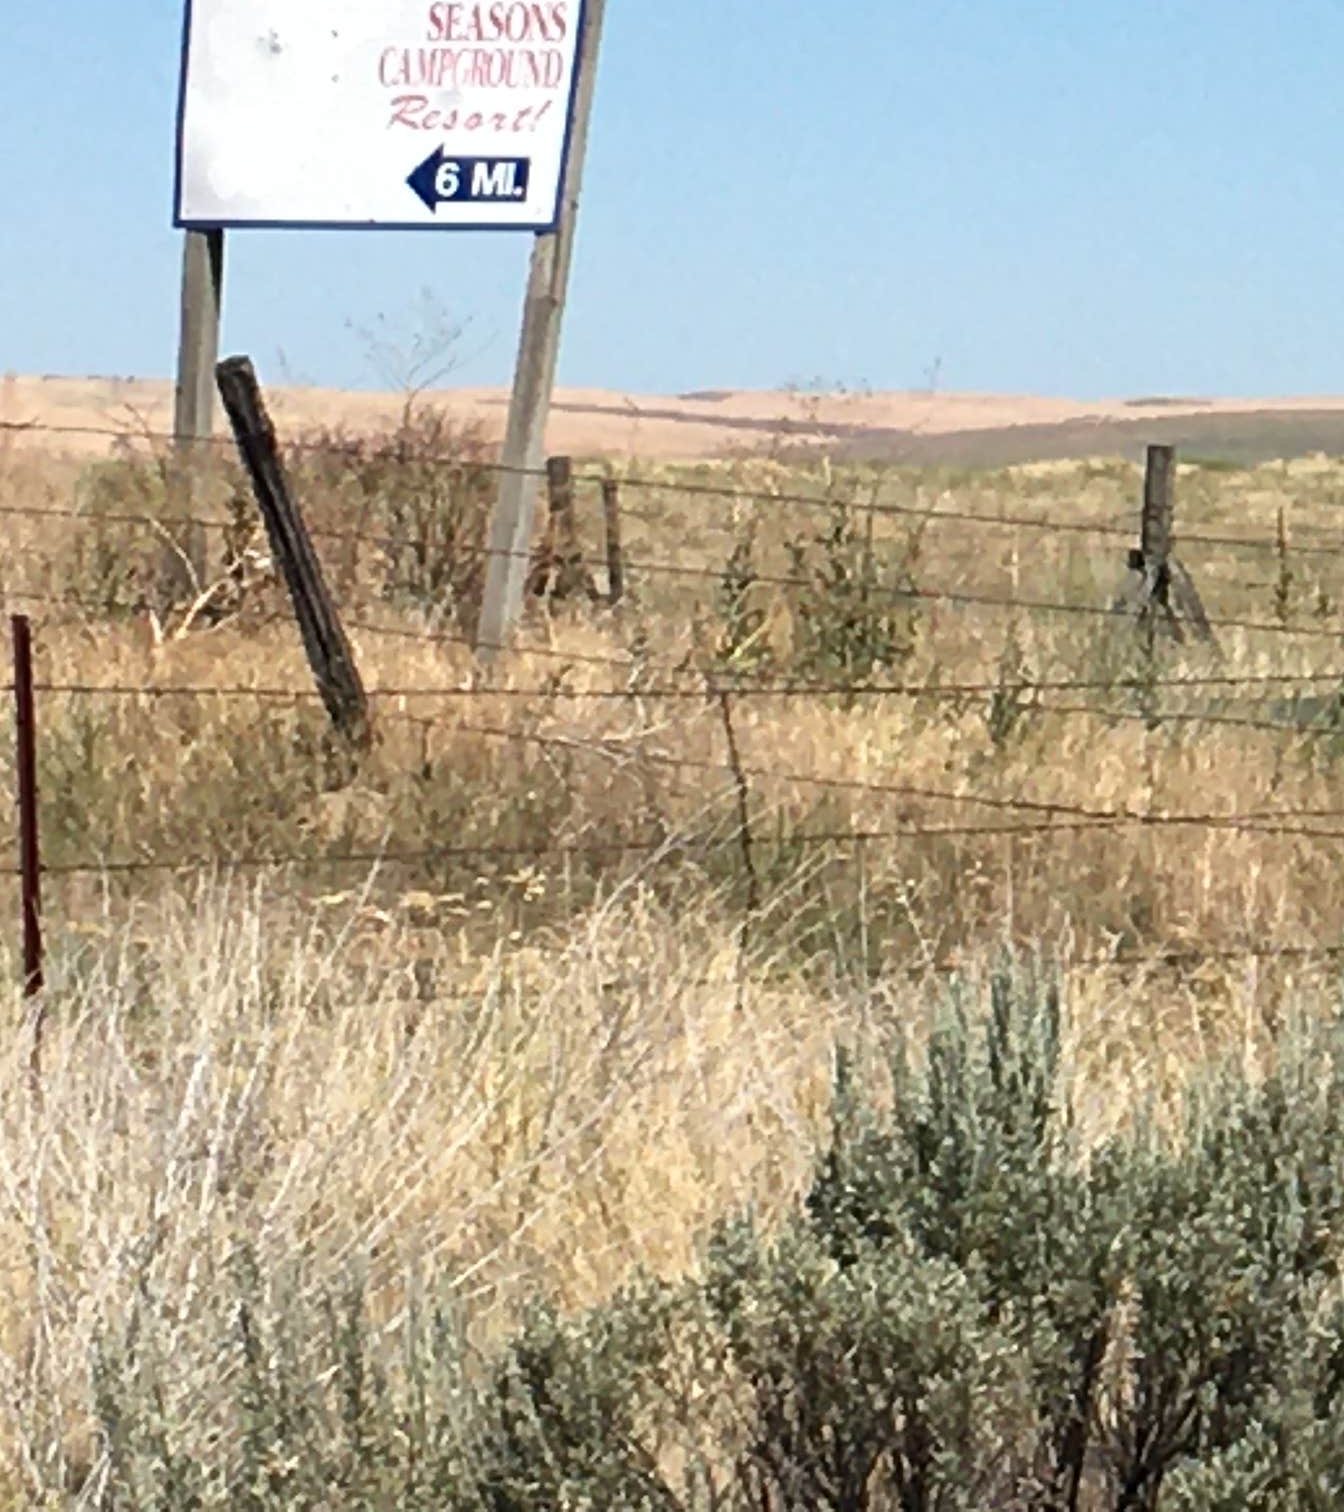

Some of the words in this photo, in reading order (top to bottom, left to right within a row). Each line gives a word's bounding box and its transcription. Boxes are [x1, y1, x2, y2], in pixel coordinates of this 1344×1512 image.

[427, 2, 567, 42] SEASONS
[378, 48, 563, 89] CAMPGROUND
[388, 95, 552, 132] Resort!
[434, 162, 459, 197] 6
